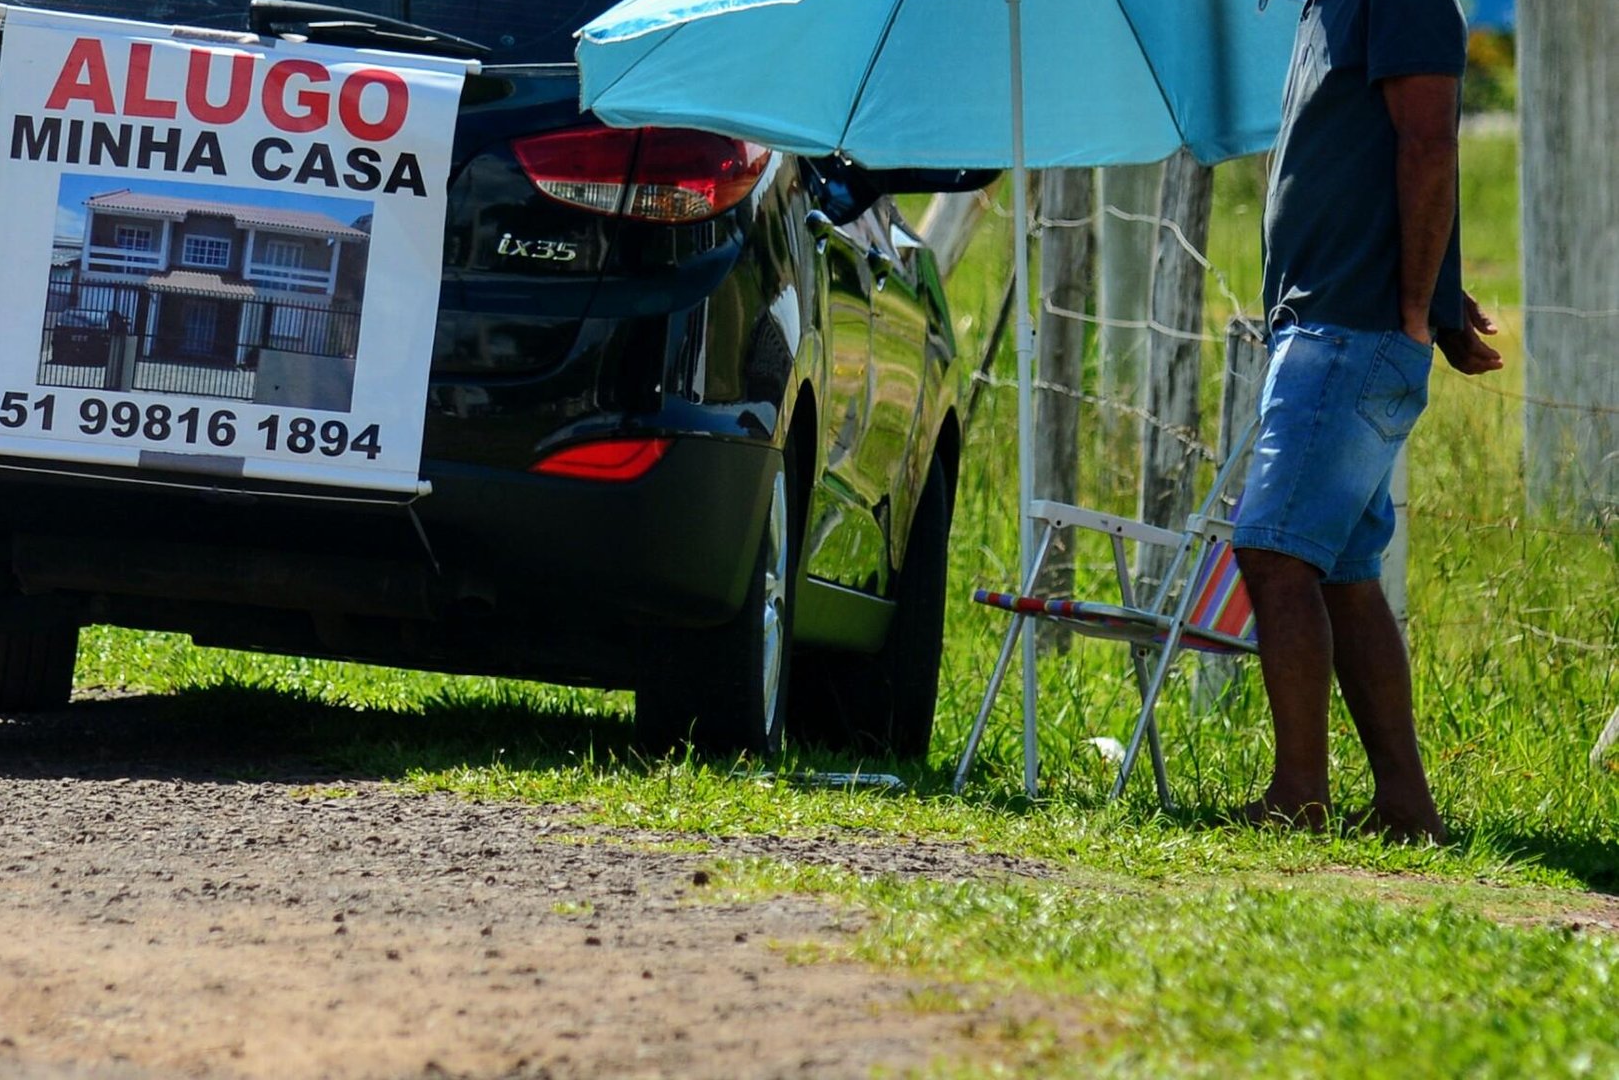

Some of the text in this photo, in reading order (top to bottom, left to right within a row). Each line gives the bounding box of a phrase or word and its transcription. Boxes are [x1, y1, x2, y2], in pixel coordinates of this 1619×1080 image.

[45, 37, 409, 142] ALUGO
[10, 115, 427, 198] MINHA CASA
[497, 233, 578, 261] ix35
[79, 398, 237, 447] 99816
[258, 414, 381, 460] 1894
